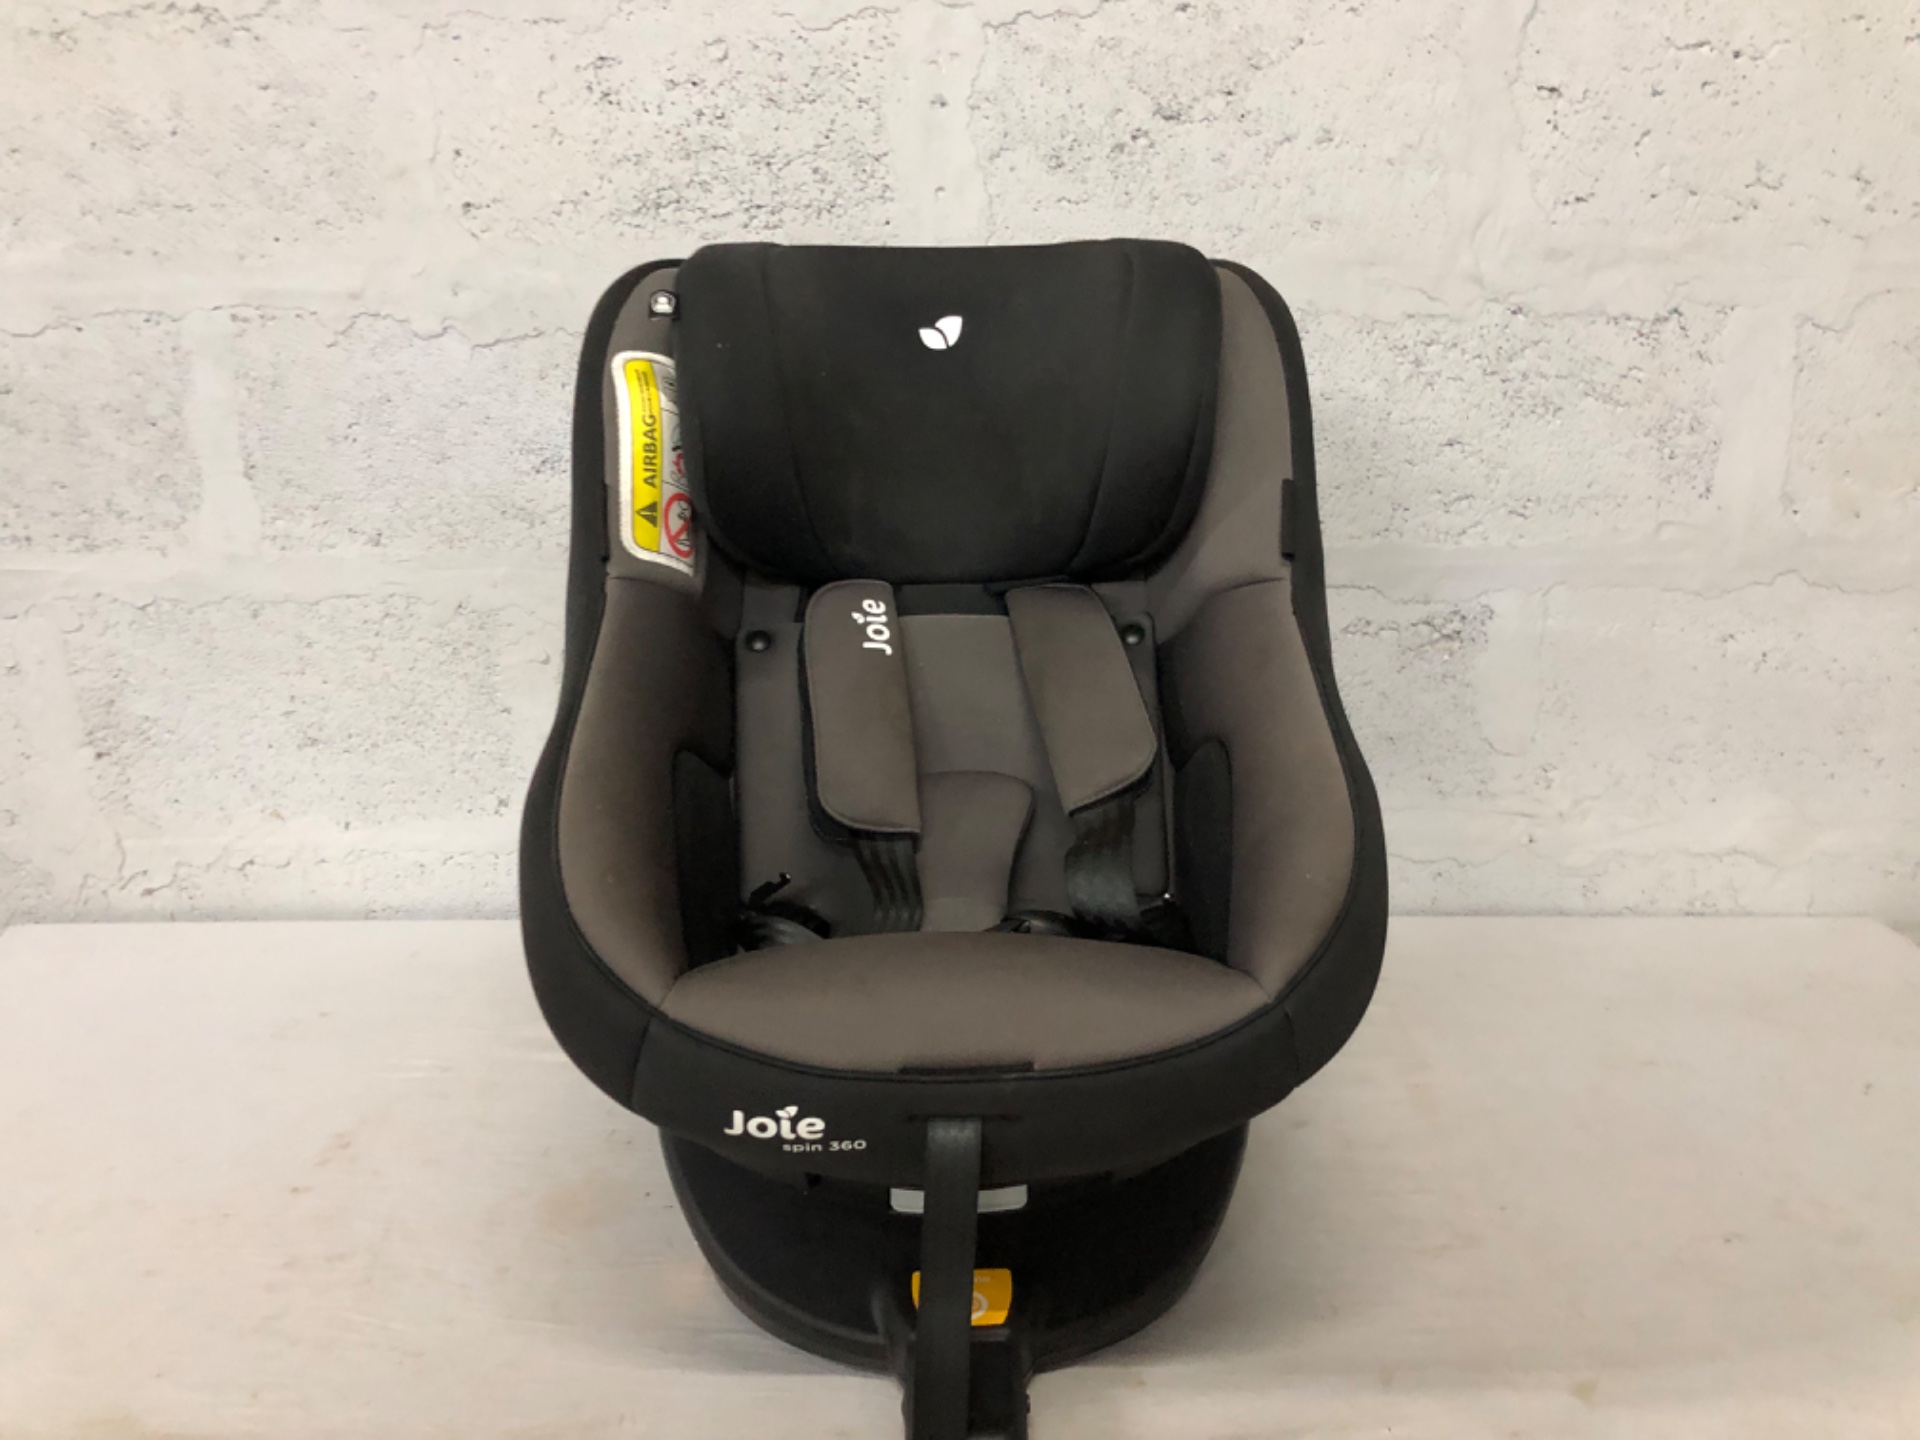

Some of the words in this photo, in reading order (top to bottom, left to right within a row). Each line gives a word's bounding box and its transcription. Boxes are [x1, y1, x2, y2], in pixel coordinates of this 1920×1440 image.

[642, 414, 658, 488] AIRBAG
[851, 599, 893, 655] Joie
[723, 1105, 826, 1140] Joie
[782, 1142, 823, 1153] spin
[828, 1139, 867, 1151] 360
